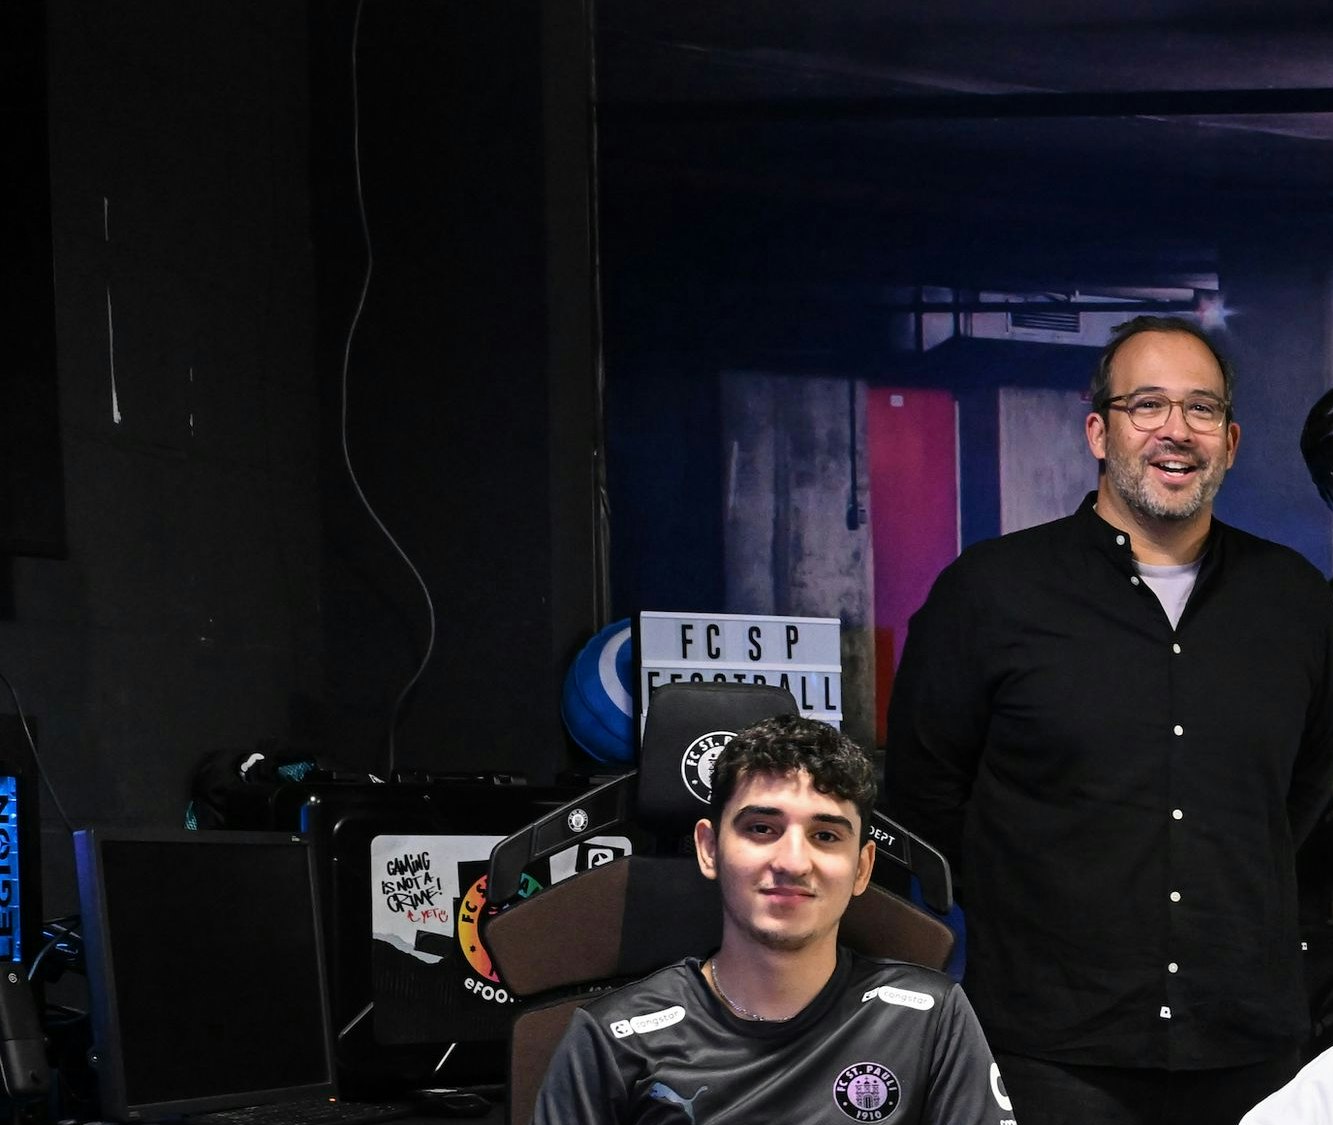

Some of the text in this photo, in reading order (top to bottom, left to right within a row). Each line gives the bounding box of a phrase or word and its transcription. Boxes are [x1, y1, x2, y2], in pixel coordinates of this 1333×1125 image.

[687, 751, 701, 767] FC
[868, 826, 896, 846] DEPT
[382, 872, 434, 895] IS NOT A
[421, 907, 440, 924] YET
[462, 900, 478, 924] FC
[836, 1065, 898, 1092] FC ST. PAULI
[856, 1110, 882, 1120] 1910
